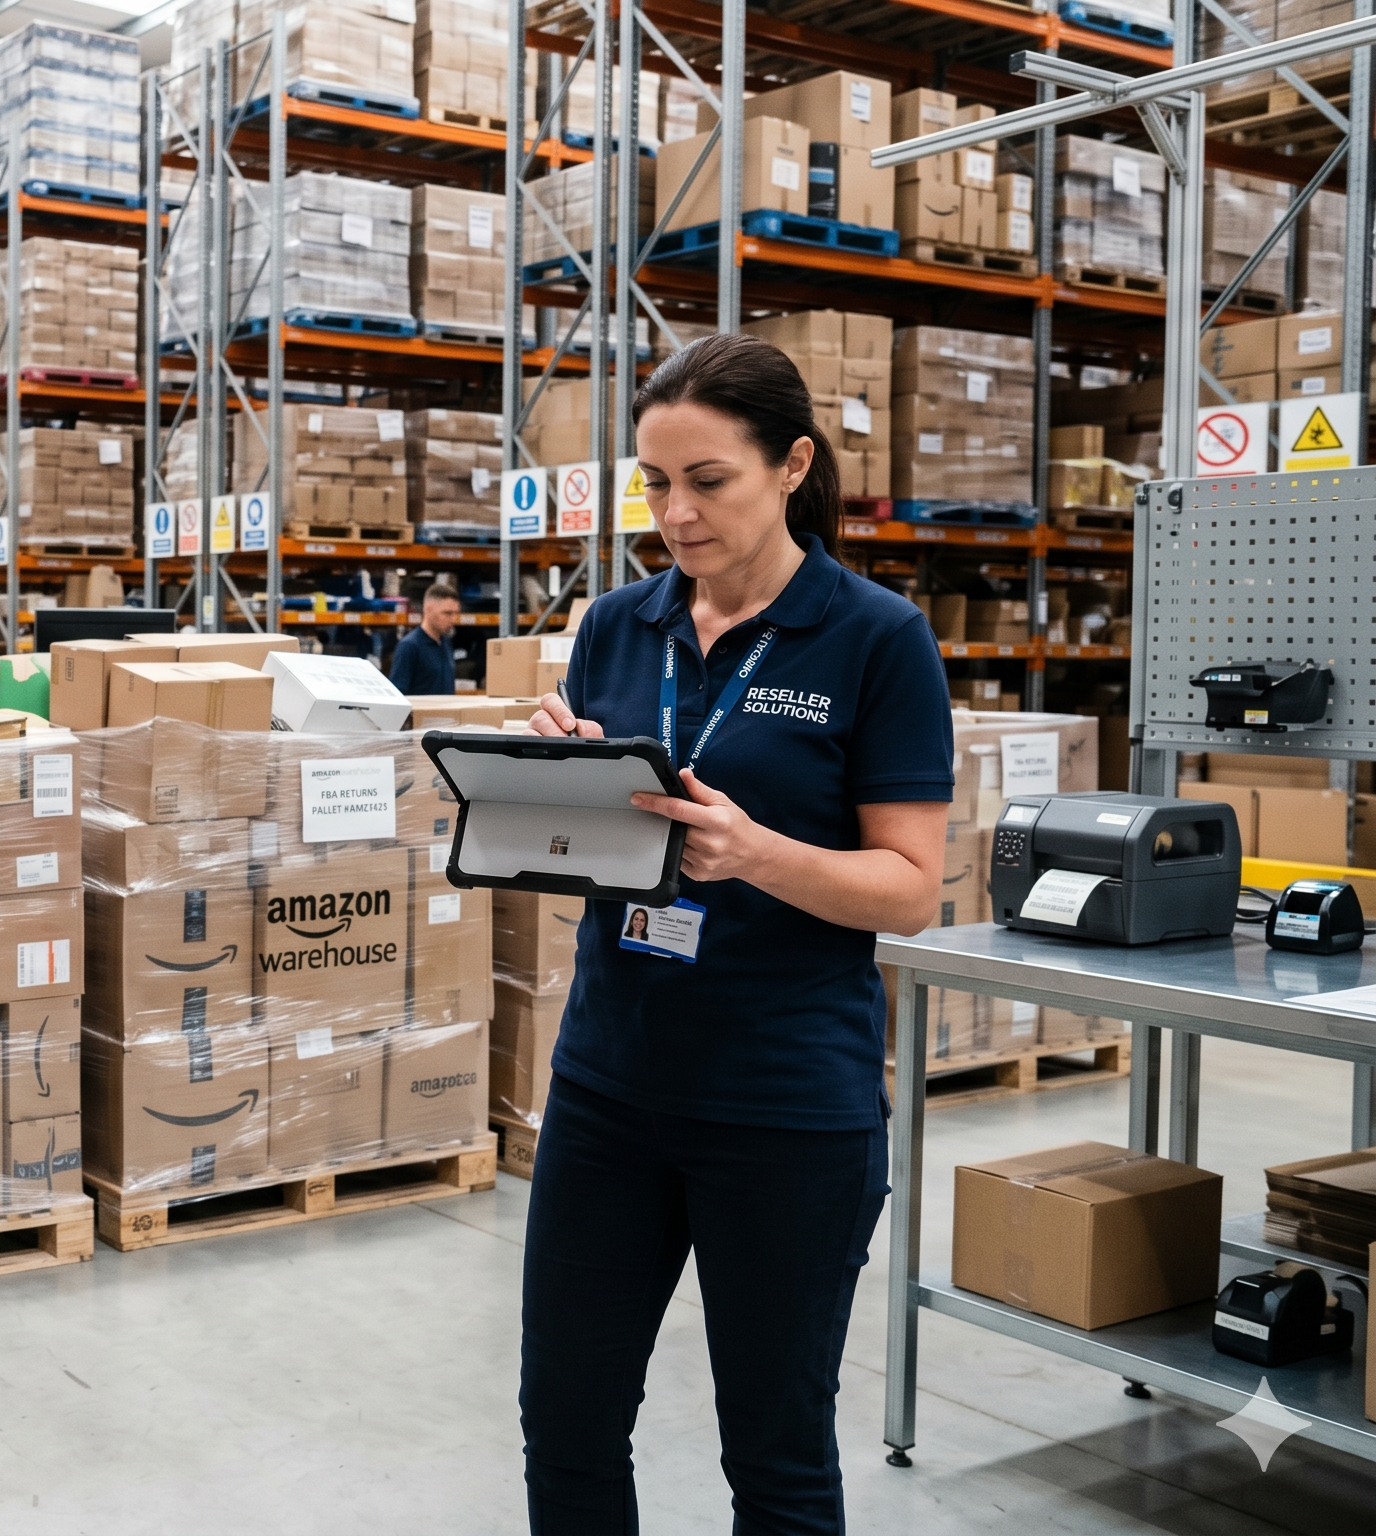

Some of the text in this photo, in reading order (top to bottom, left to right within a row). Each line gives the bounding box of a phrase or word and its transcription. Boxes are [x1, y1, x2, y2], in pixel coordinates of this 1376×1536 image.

[747, 687, 831, 710] RESELLER
[742, 701, 829, 724] SOLUTIONS
[321, 788, 378, 799] FBA RETURNS
[312, 805, 342, 815] PALLET
[267, 889, 391, 924] amazon
[258, 940, 397, 973] warehouse
